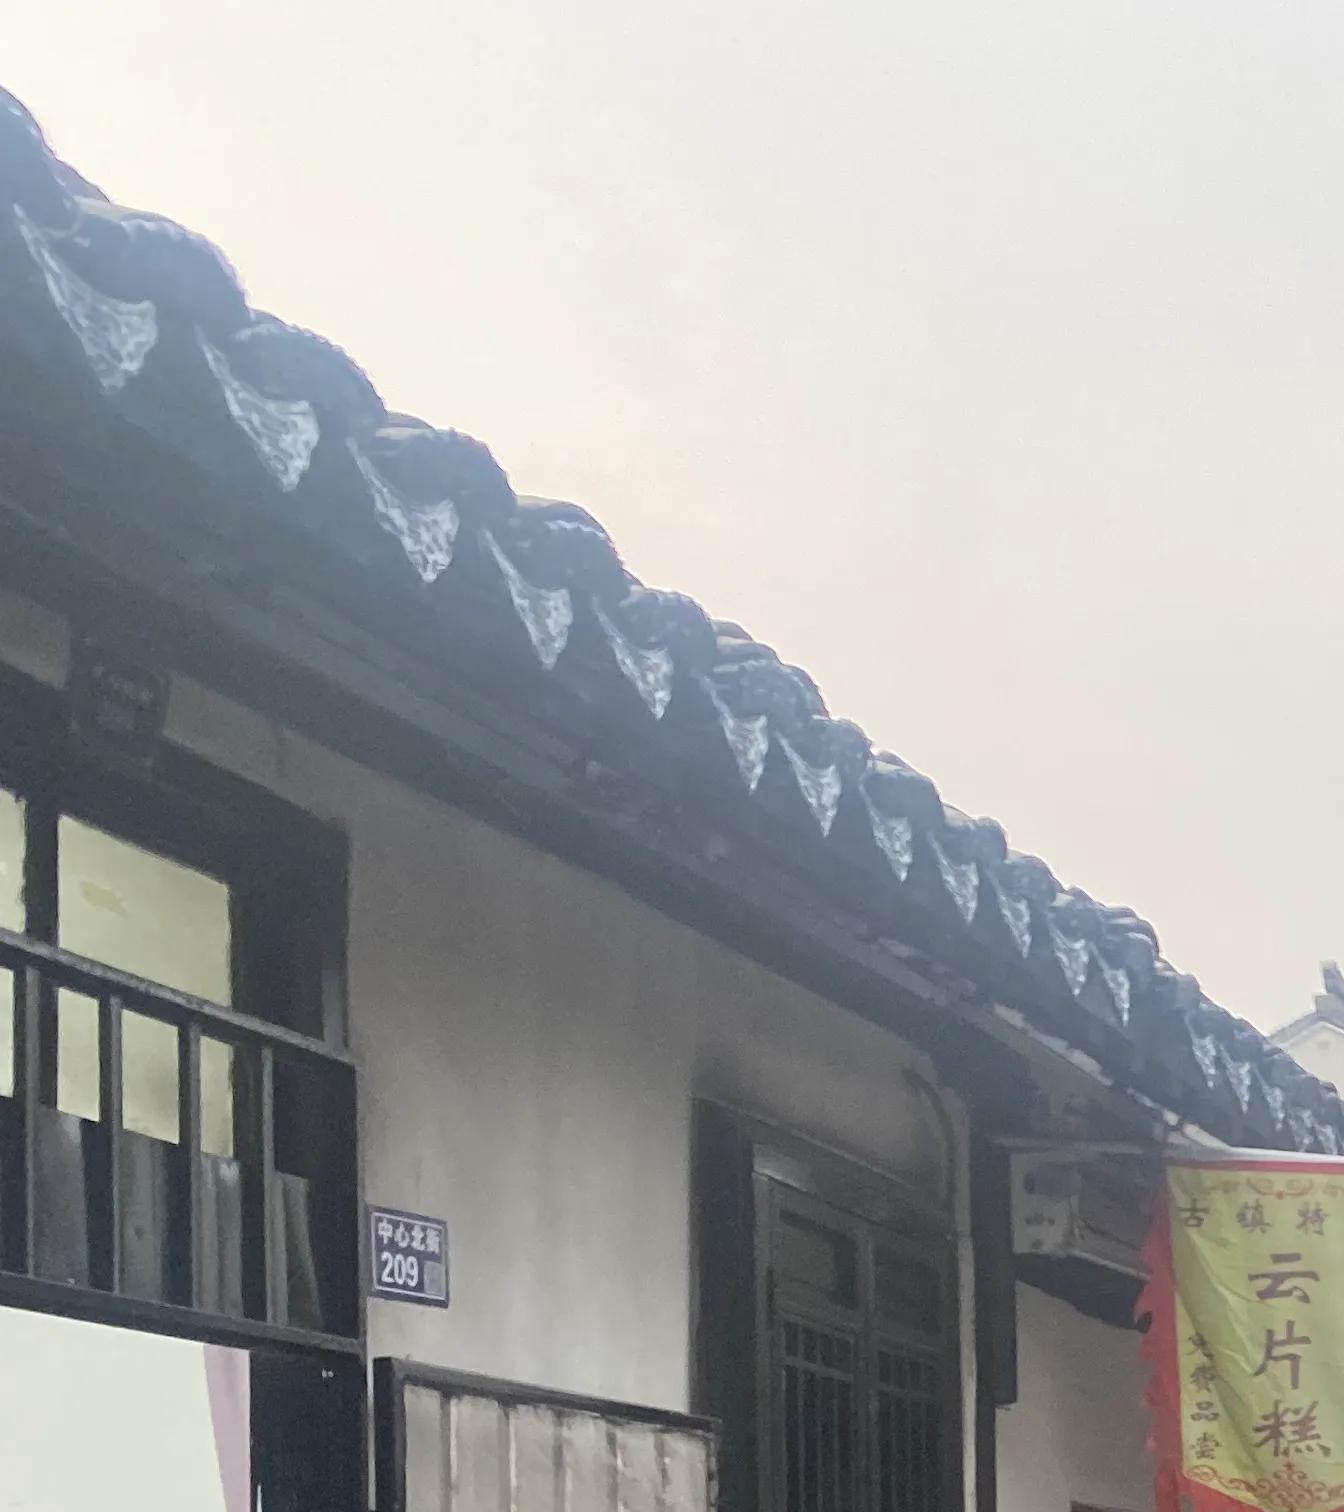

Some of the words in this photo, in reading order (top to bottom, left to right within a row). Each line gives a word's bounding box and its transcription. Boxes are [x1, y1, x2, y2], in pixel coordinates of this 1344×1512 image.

[377, 1217, 440, 1255] 中心北街
[380, 1251, 419, 1288] 209
[1247, 1252, 1332, 1459] 云片糕
